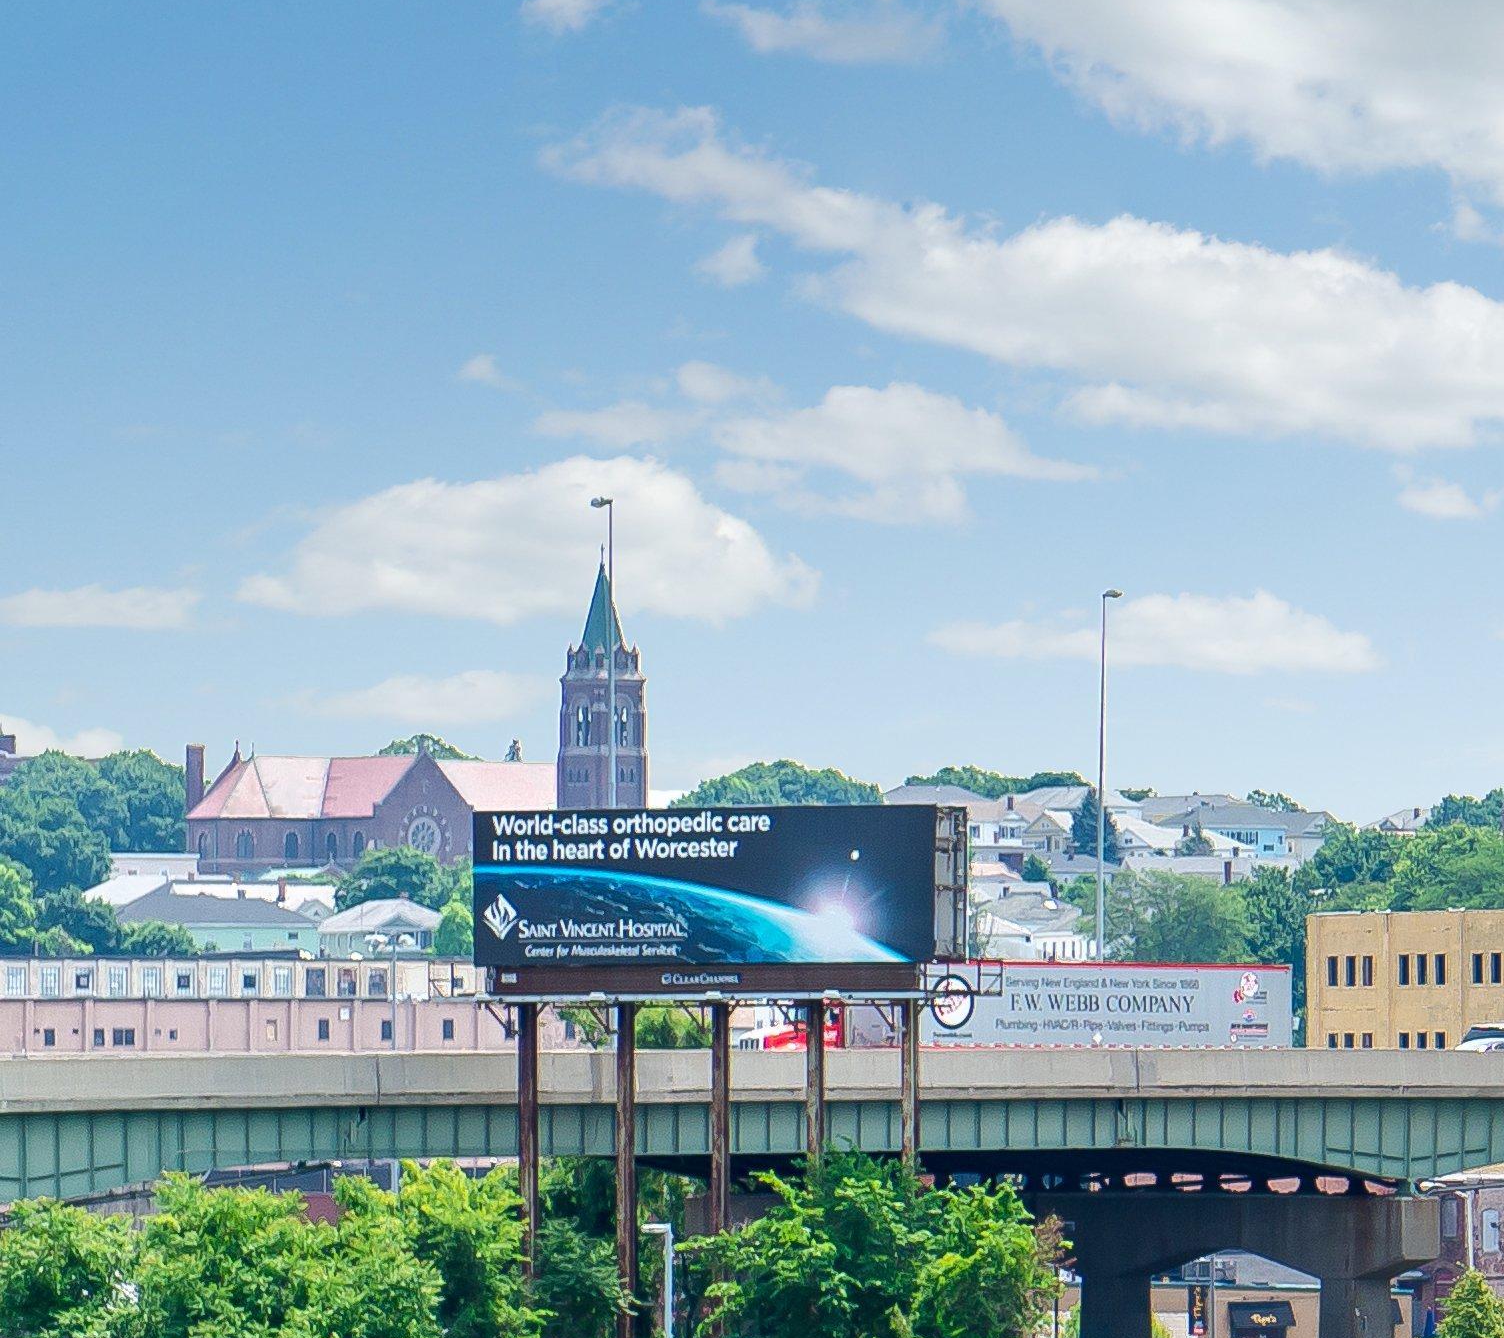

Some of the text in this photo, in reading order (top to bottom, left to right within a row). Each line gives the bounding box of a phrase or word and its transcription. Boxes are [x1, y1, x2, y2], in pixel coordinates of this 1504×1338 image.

[492, 812, 771, 839] World-class orthopedic care
[492, 839, 738, 861] In the heart of Worcester
[518, 919, 557, 939] SAINT
[560, 919, 616, 939] VINCENT
[525, 944, 555, 958] Center
[557, 943, 569, 959] for
[1005, 976, 1039, 990] Serving
[1041, 976, 1061, 988] New
[1063, 976, 1099, 990] England
[1109, 977, 1130, 988] New
[1130, 977, 1151, 988] York
[1153, 977, 1178, 989] Since
[1011, 994, 1195, 1014] F.W. WEBB COMPANY
